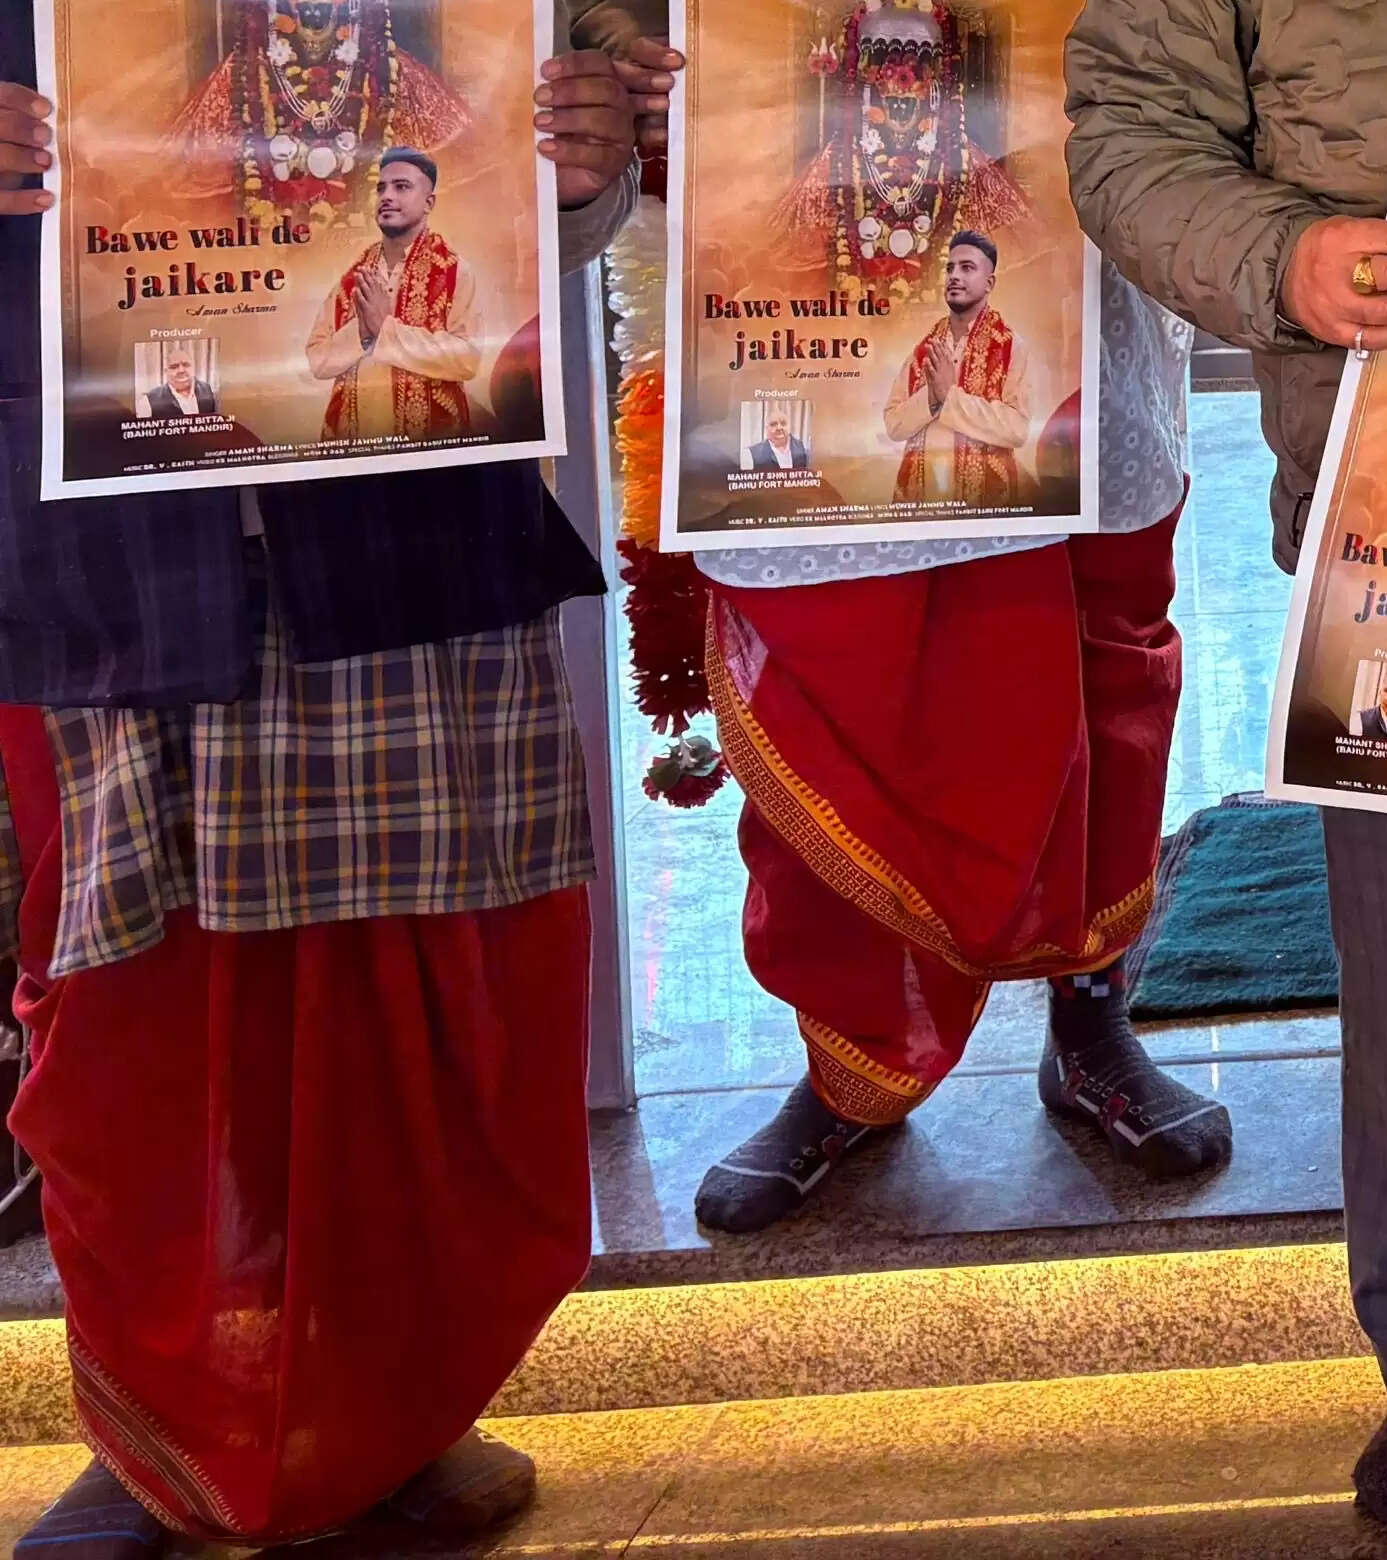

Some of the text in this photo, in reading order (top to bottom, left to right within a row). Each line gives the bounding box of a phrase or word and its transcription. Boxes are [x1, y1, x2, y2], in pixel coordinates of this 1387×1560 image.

[85, 214, 310, 254] Bawe wali de
[116, 262, 285, 309] jaikare
[186, 301, 277, 316] Aman Sharma
[704, 289, 890, 319] Bawe wali de
[149, 326, 201, 338] Producer
[729, 329, 869, 370] jaikare
[754, 388, 798, 397] Producer
[120, 419, 165, 429] MAHANT
[167, 417, 192, 426] SHRI
[194, 415, 225, 424] BITTA
[122, 423, 234, 439] (BAHU FORT MANDIR)
[228, 444, 293, 455] AMAN SHARMA
[727, 472, 764, 480] MAHANT
[766, 471, 788, 479] SHRI
[788, 470, 814, 478] BITTA
[727, 479, 821, 490] (BAHU FORT MANDIR)
[1334, 736, 1373, 747] MAHANT
[1335, 745, 1365, 755] (BAHU
